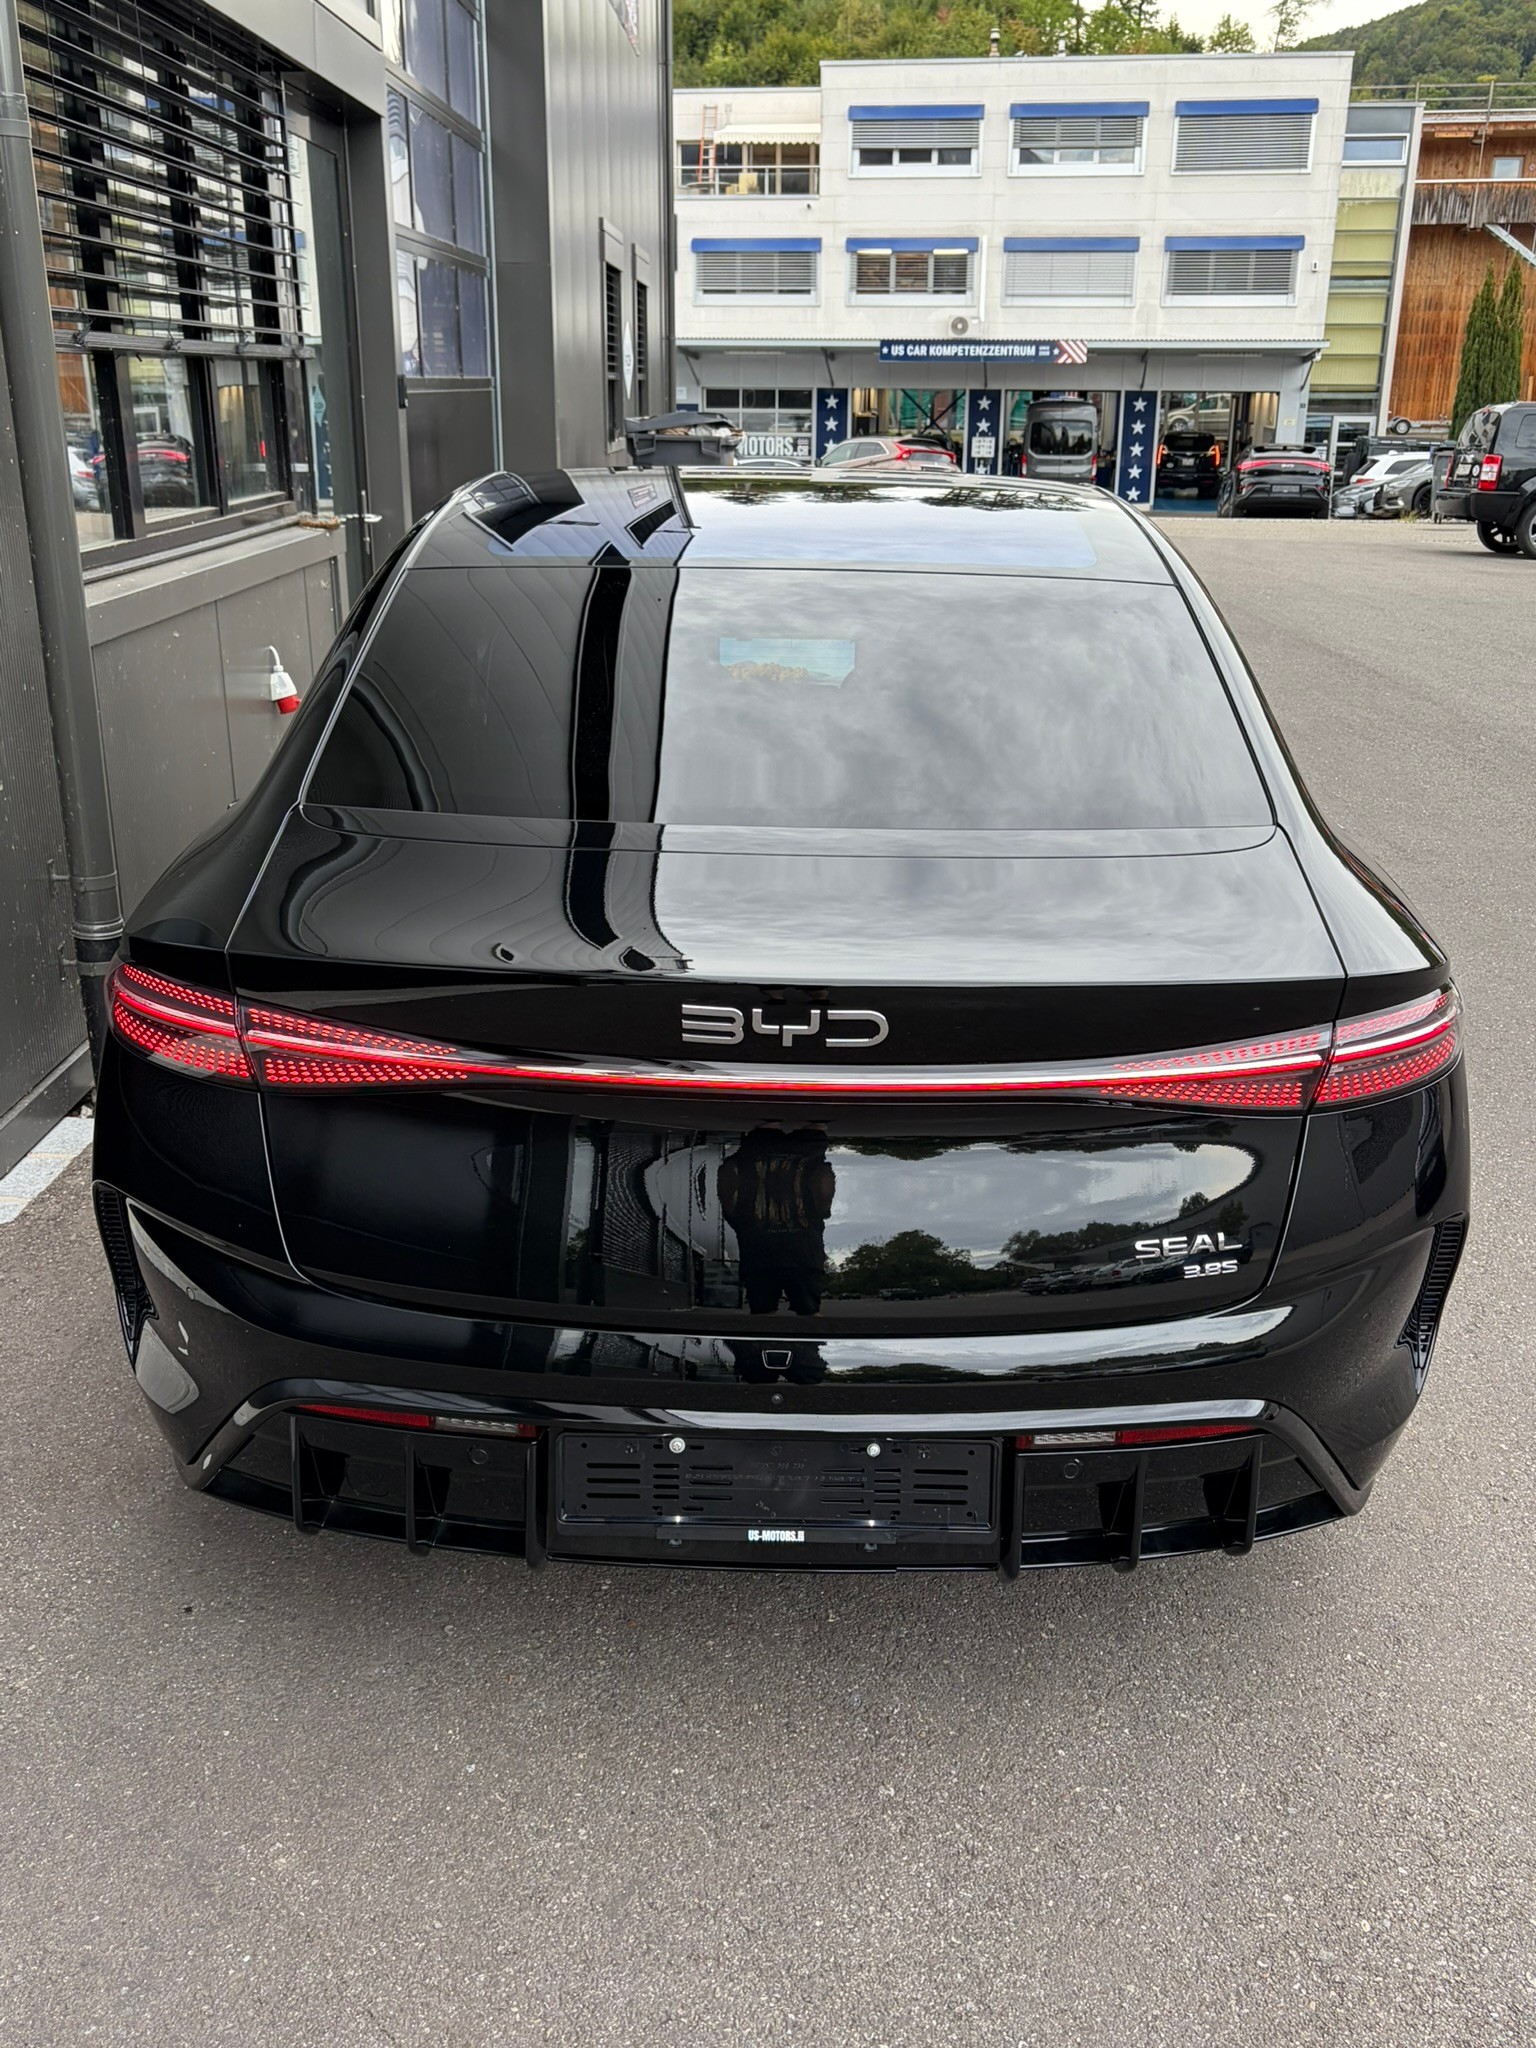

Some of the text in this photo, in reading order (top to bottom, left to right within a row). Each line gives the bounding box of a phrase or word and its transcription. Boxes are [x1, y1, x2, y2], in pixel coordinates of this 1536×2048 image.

[891, 343, 905, 355] US
[906, 343, 927, 356] CAR
[929, 344, 1036, 357] KOMPETENZZENTRUM
[681, 1004, 889, 1048] BYD
[1135, 1232, 1243, 1259] SEAL
